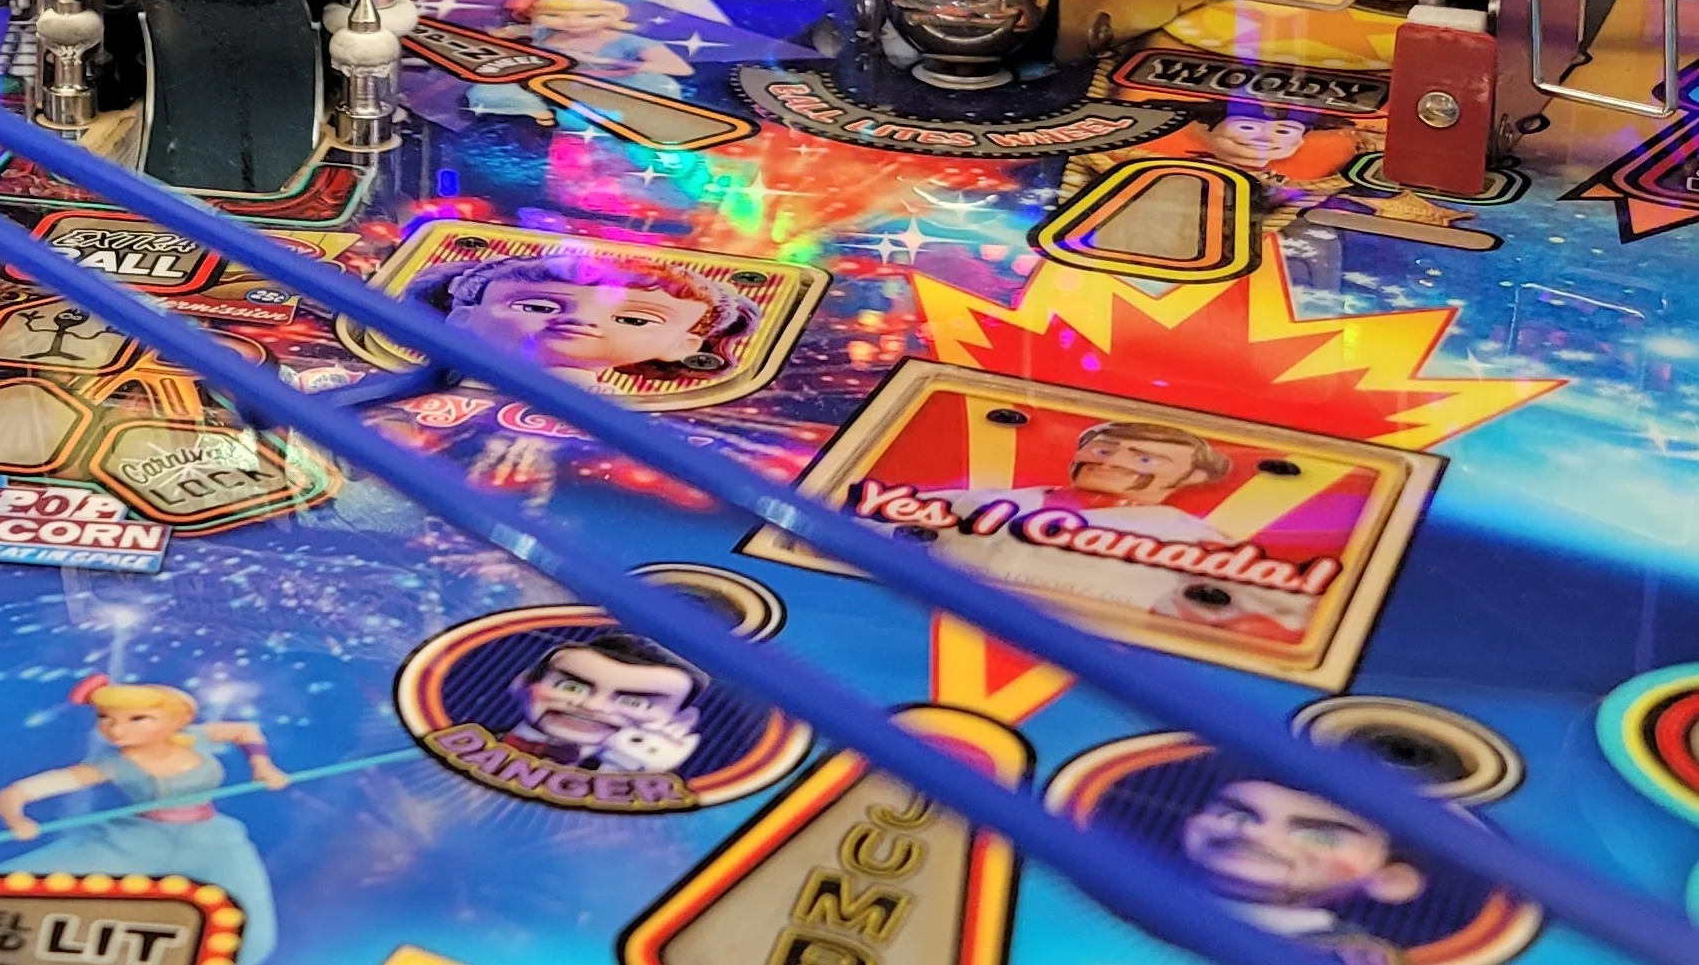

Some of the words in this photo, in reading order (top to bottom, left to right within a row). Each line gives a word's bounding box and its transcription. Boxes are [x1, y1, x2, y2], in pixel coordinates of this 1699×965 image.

[1146, 56, 1372, 112] WOODY
[768, 82, 839, 125] BALL
[847, 118, 978, 148] LITES
[987, 114, 1135, 148] WHEEL
[49, 227, 201, 253] EXTRA
[153, 295, 290, 322] ermission
[118, 440, 228, 486] Carniv
[149, 467, 275, 506] LOCK
[70, 550, 156, 570] SPACE
[855, 479, 960, 528] Yes
[971, 499, 1018, 535] I
[1021, 508, 1343, 596] Canada!
[428, 724, 692, 809] DANGER
[36, 913, 190, 965] LIT
